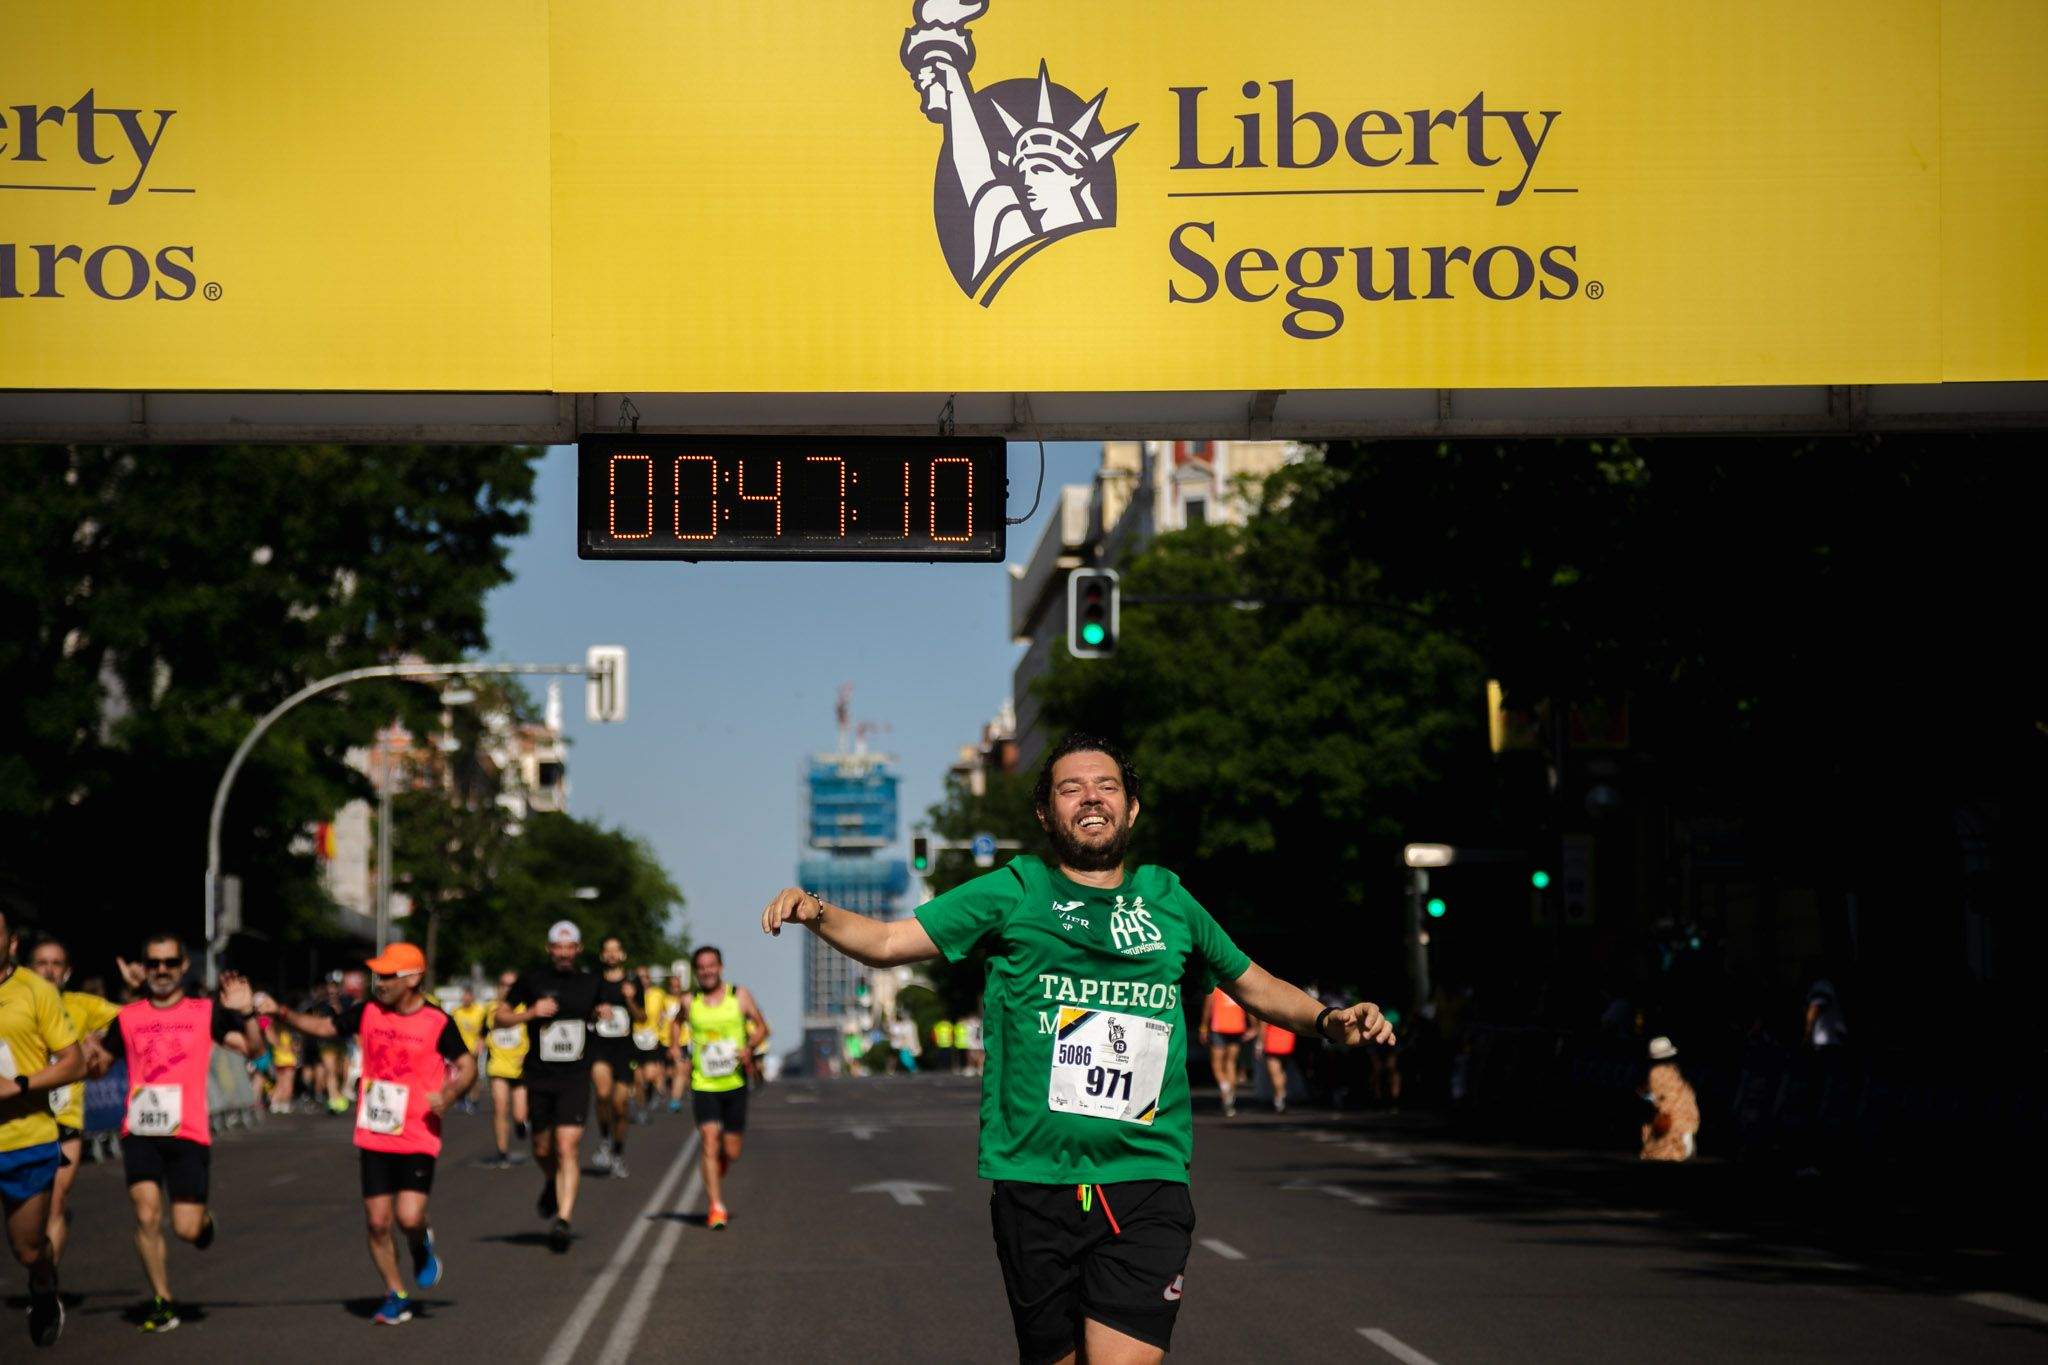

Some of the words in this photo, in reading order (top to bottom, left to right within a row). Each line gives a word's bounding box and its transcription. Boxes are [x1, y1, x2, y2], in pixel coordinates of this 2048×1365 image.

[0, 87, 177, 205] rty
[1168, 79, 1562, 206] Liberty
[1039, 974, 1177, 1009] TAPIEROS
[1058, 1044, 1092, 1066] 5086
[1086, 1066, 1133, 1101] 971
